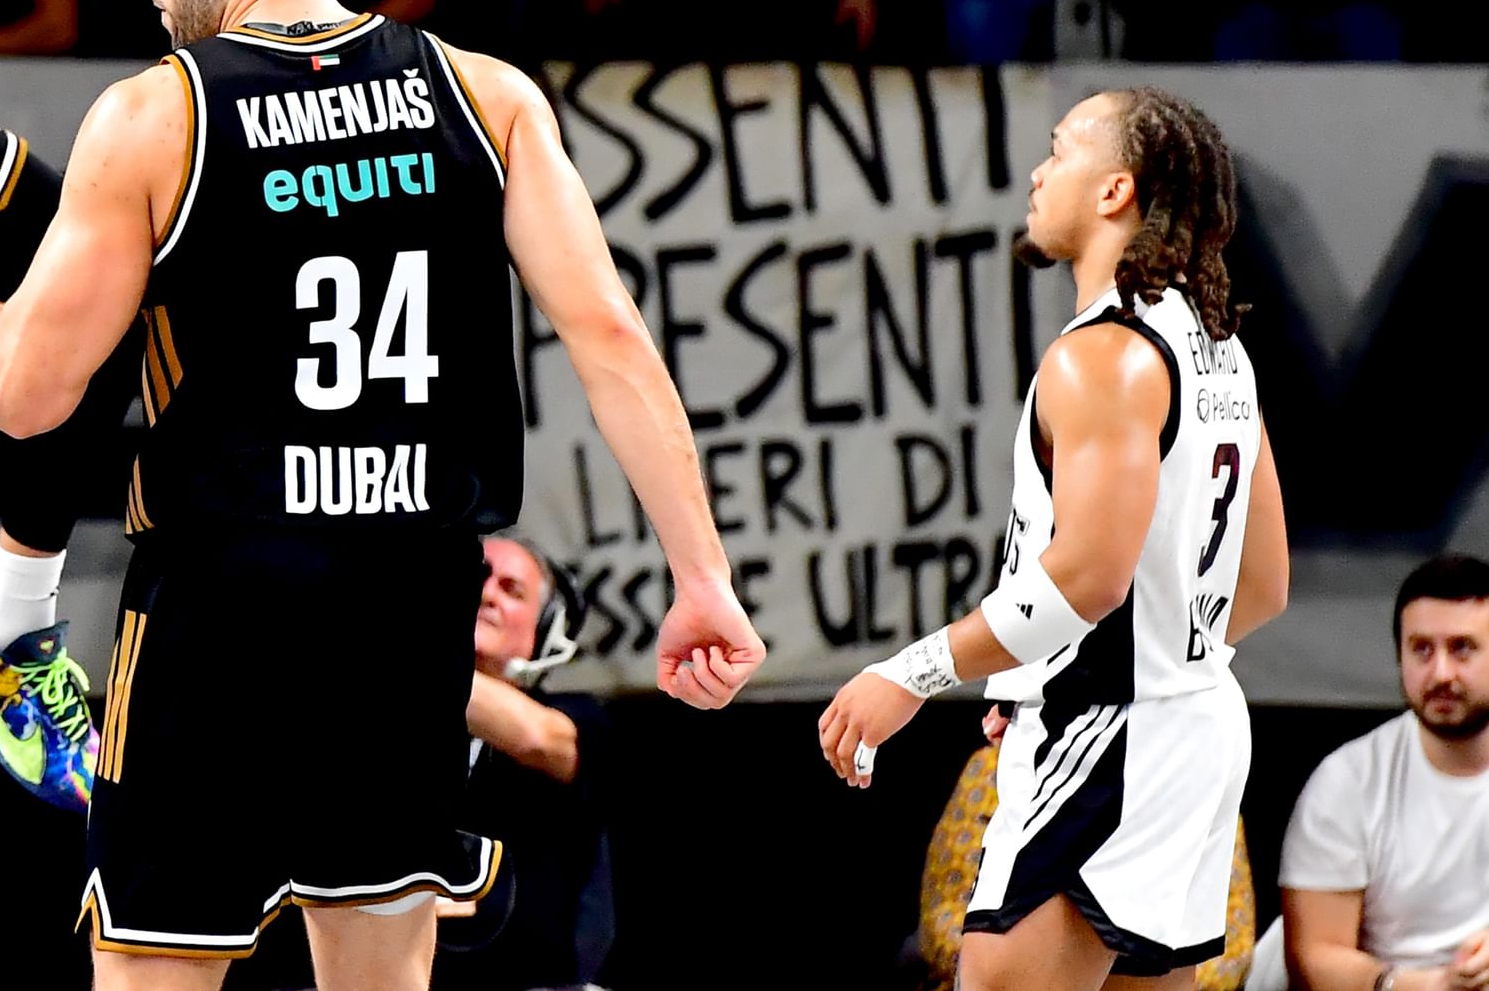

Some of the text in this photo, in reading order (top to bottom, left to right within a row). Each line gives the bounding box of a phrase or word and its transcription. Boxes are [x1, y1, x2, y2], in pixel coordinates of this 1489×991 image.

[236, 68, 436, 149] KAMENJAŠ
[295, 250, 439, 410] 34
[284, 443, 431, 515] DUBAI
[895, 423, 982, 529] DI
[1197, 443, 1241, 577] 3
